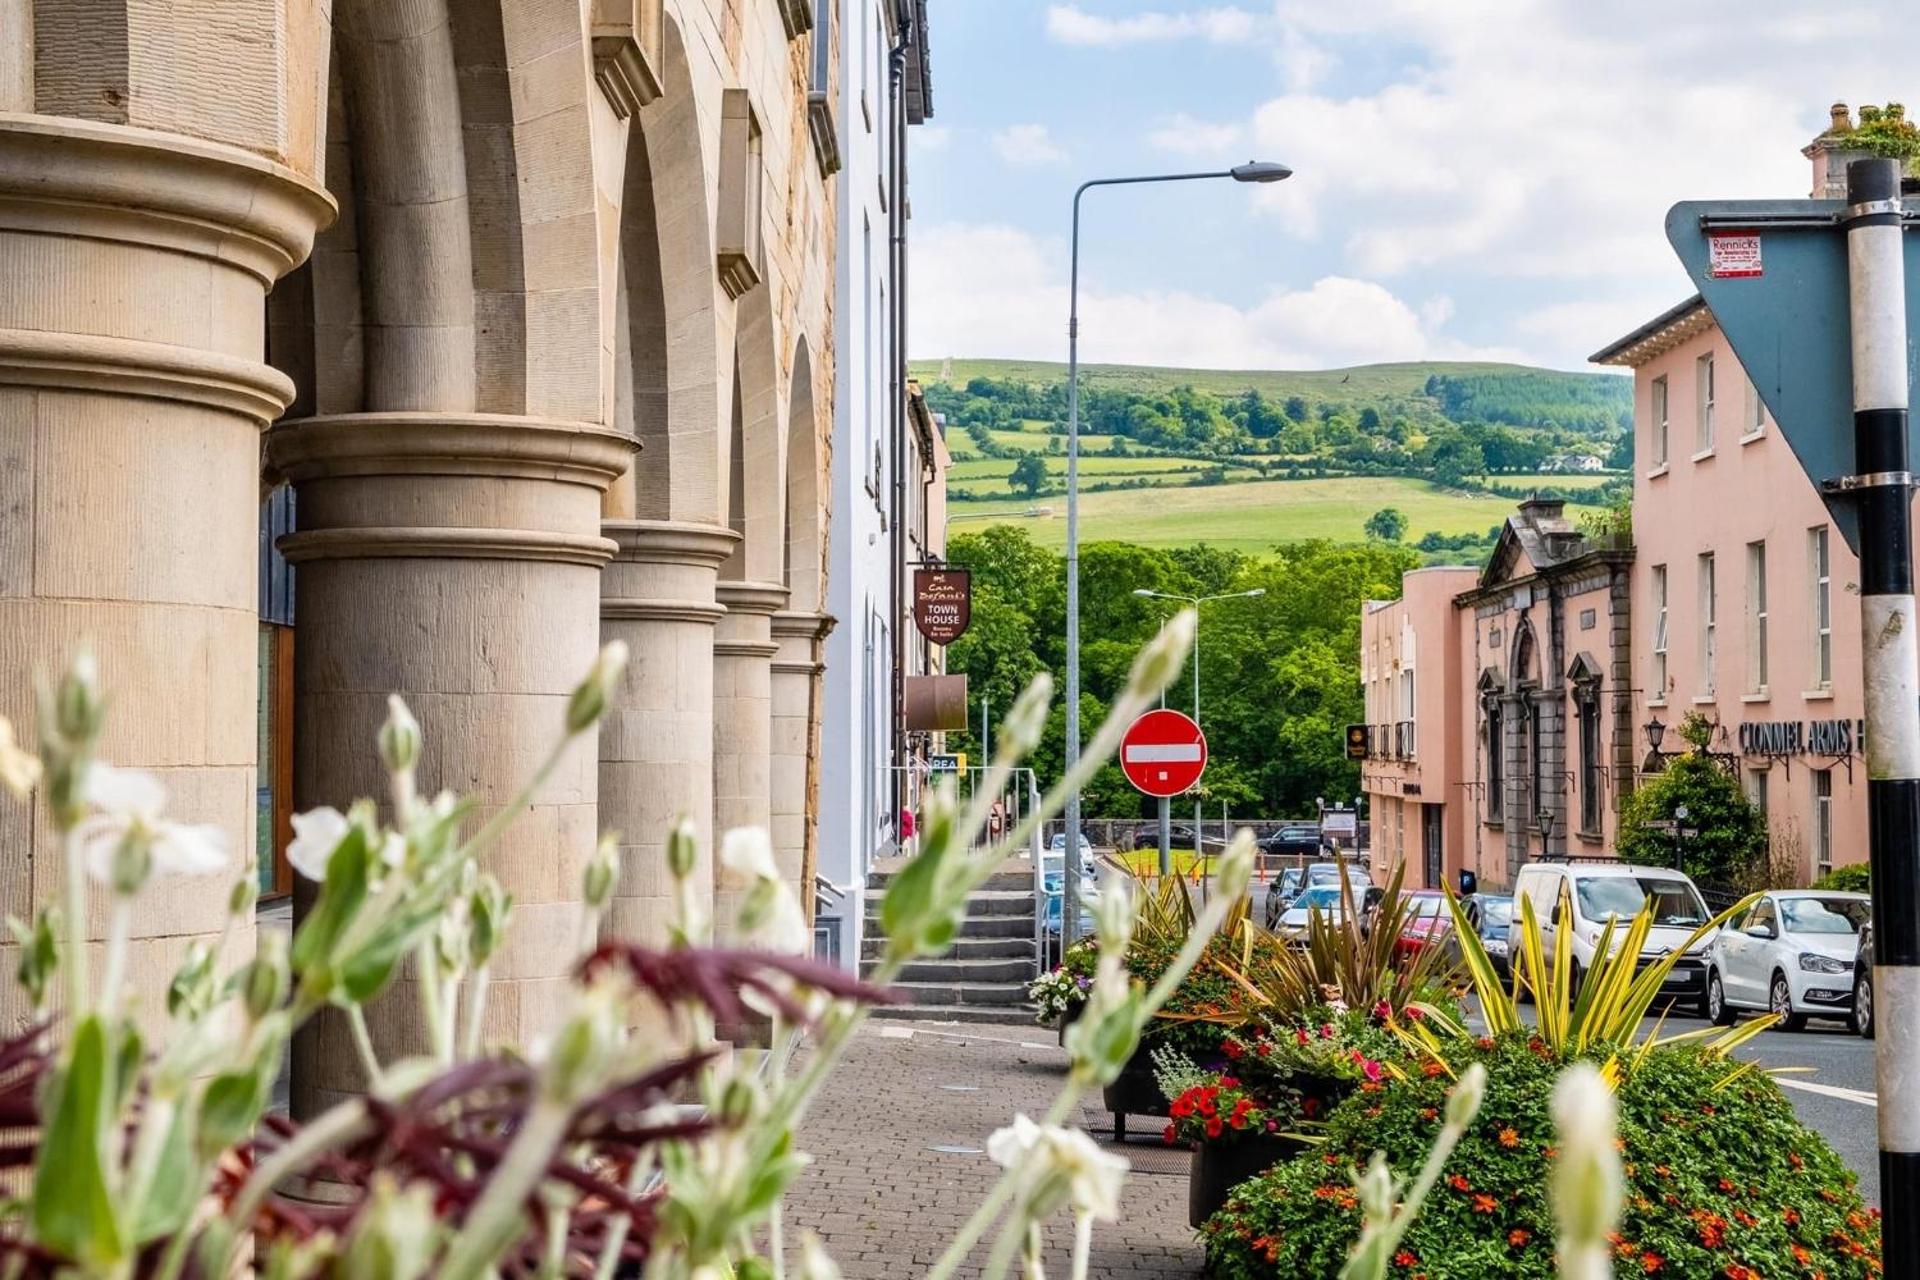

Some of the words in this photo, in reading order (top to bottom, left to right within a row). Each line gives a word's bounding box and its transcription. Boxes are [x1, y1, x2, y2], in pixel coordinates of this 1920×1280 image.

[1713, 239, 1759, 250] Rennicks
[928, 583, 954, 591] Casa
[928, 604, 958, 614] TOWN
[924, 615, 960, 624] HOUSE
[1739, 721, 1805, 755] CLONMEL
[1807, 719, 1852, 755] ARMS
